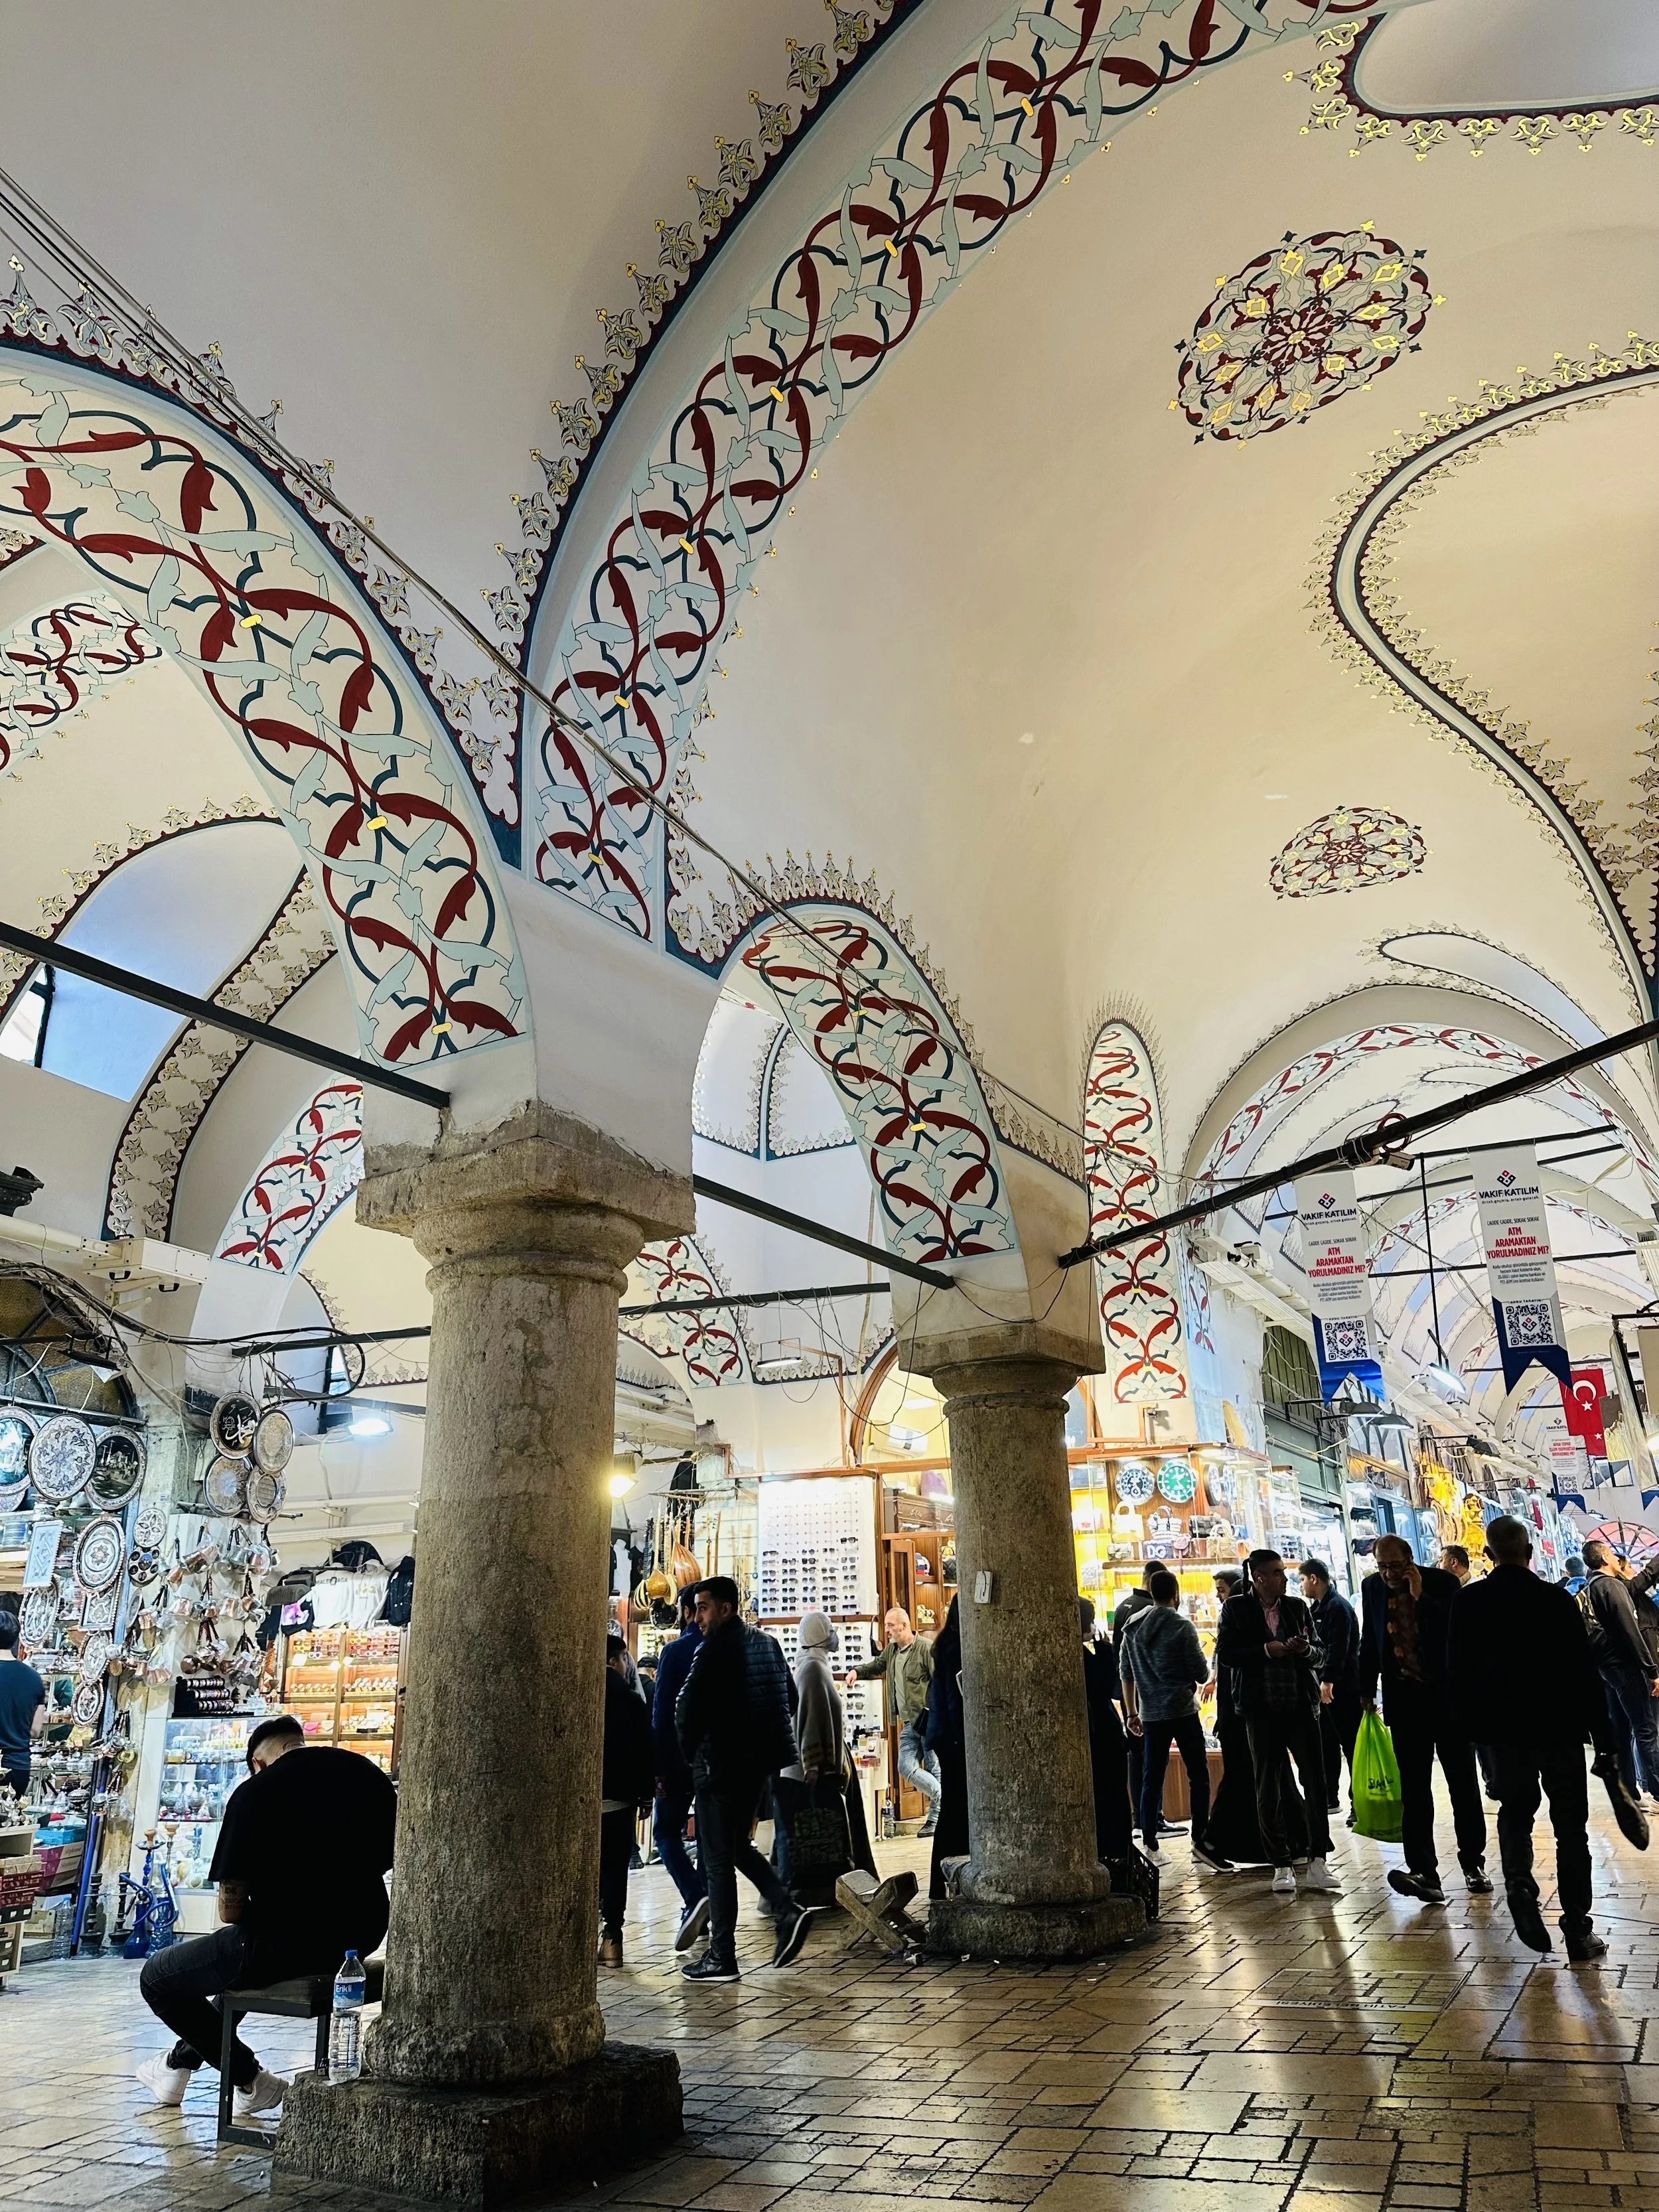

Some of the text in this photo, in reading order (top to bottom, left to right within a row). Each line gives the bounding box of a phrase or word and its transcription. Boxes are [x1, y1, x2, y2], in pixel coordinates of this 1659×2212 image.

[1479, 1186, 1539, 1199] VAKIF KATILIM
[1301, 1208, 1357, 1220] VAKIF KATILIM
[1508, 1226, 1522, 1236] ATM
[1495, 1236, 1536, 1248] ARAMAKTAN
[1328, 1247, 1340, 1256] ATM
[1486, 1246, 1550, 1259] YORULMADINIZ MI?
[1316, 1256, 1354, 1266] ARAMAKTAN
[1308, 1266, 1354, 1278] YORULMADINIZ
[1147, 1545, 1167, 1558] DG
